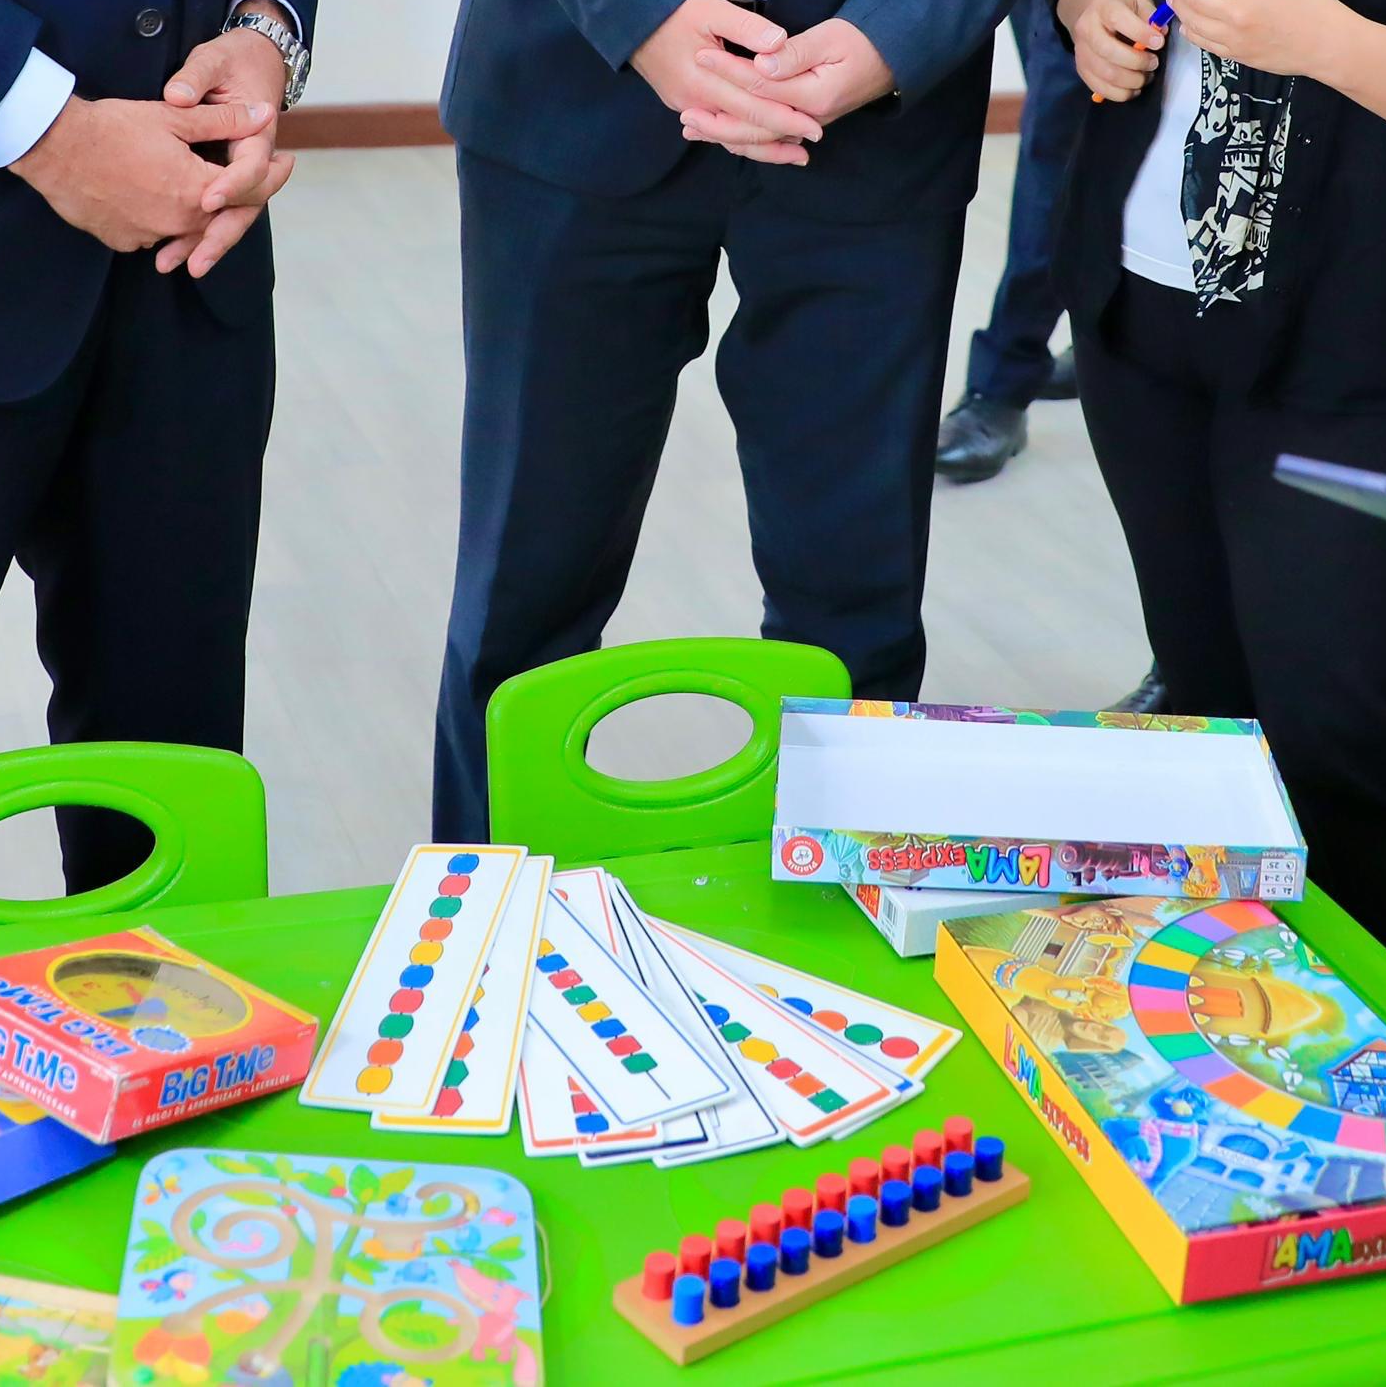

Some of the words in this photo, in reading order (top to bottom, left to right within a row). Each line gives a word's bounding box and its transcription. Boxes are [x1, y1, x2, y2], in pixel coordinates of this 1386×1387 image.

[866, 842, 967, 872] EXPRESS
[965, 844, 1052, 889] LAMA
[1259, 1226, 1353, 1284] LAMA
